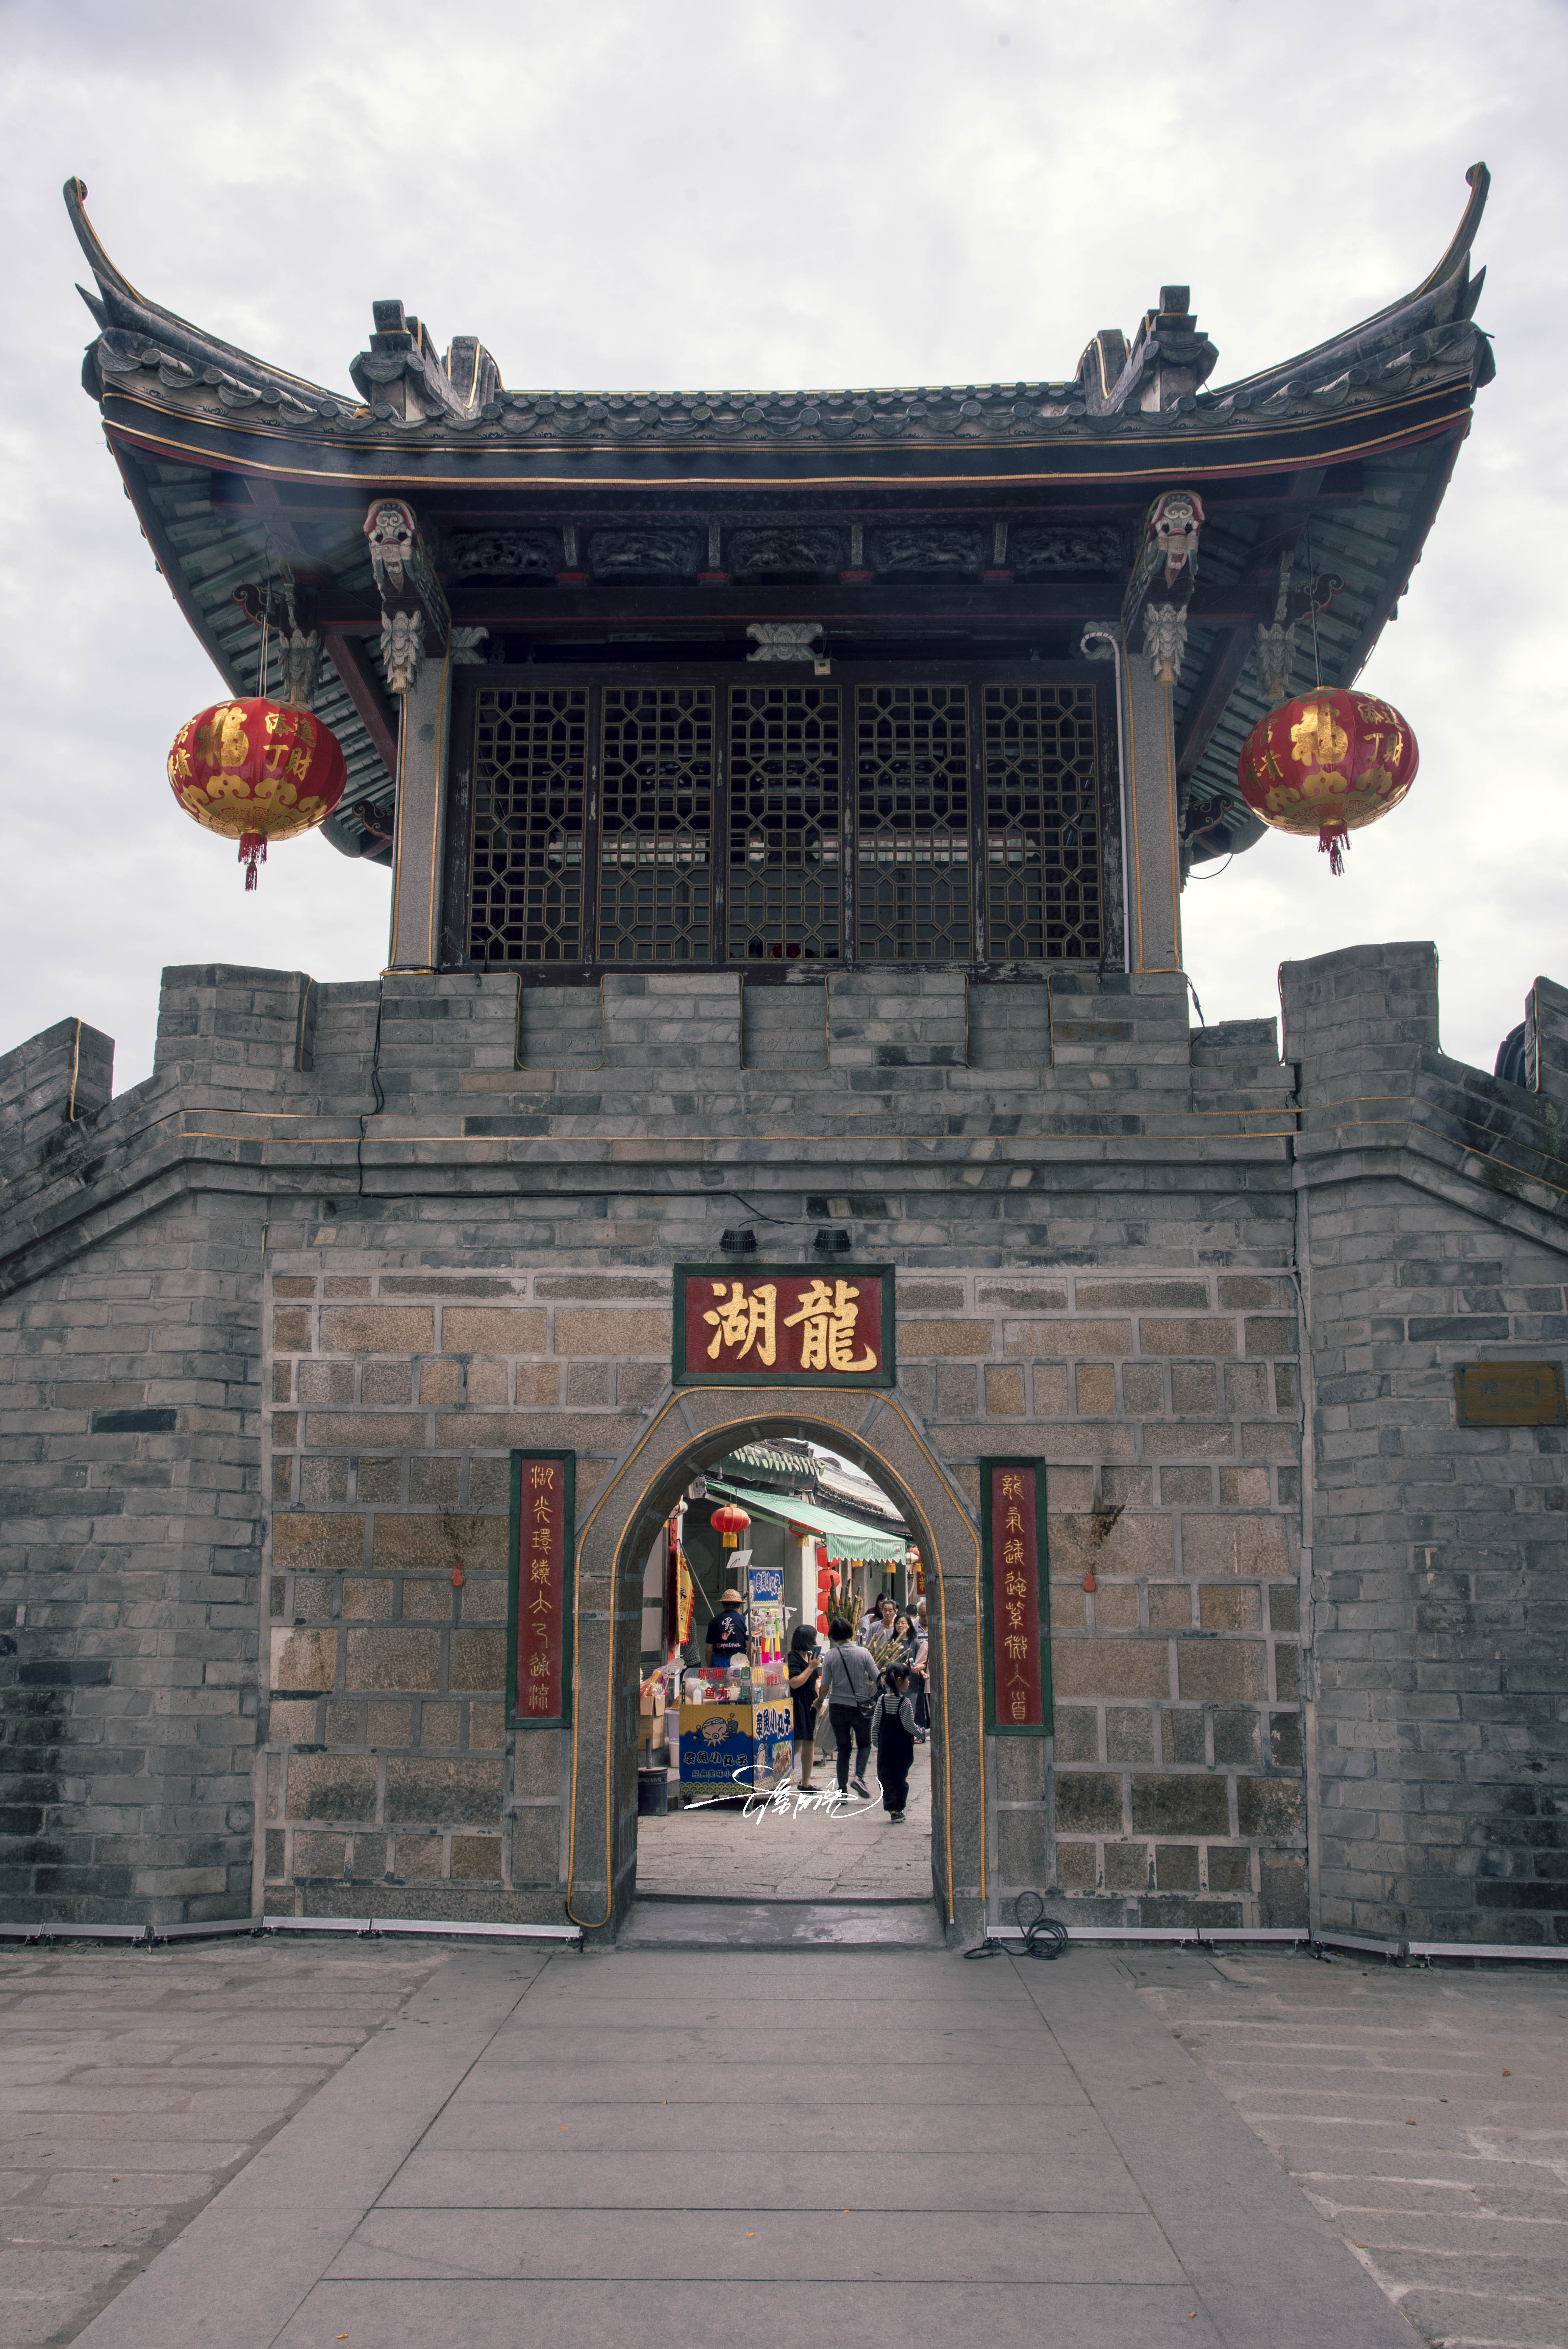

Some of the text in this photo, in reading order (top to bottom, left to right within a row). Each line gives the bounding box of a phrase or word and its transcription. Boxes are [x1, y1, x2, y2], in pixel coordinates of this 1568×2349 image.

[196, 707, 249, 768] 福
[1290, 702, 1348, 766] 福
[698, 1668, 725, 1681] 咖喱
[704, 1686, 730, 1700] 鱼丸
